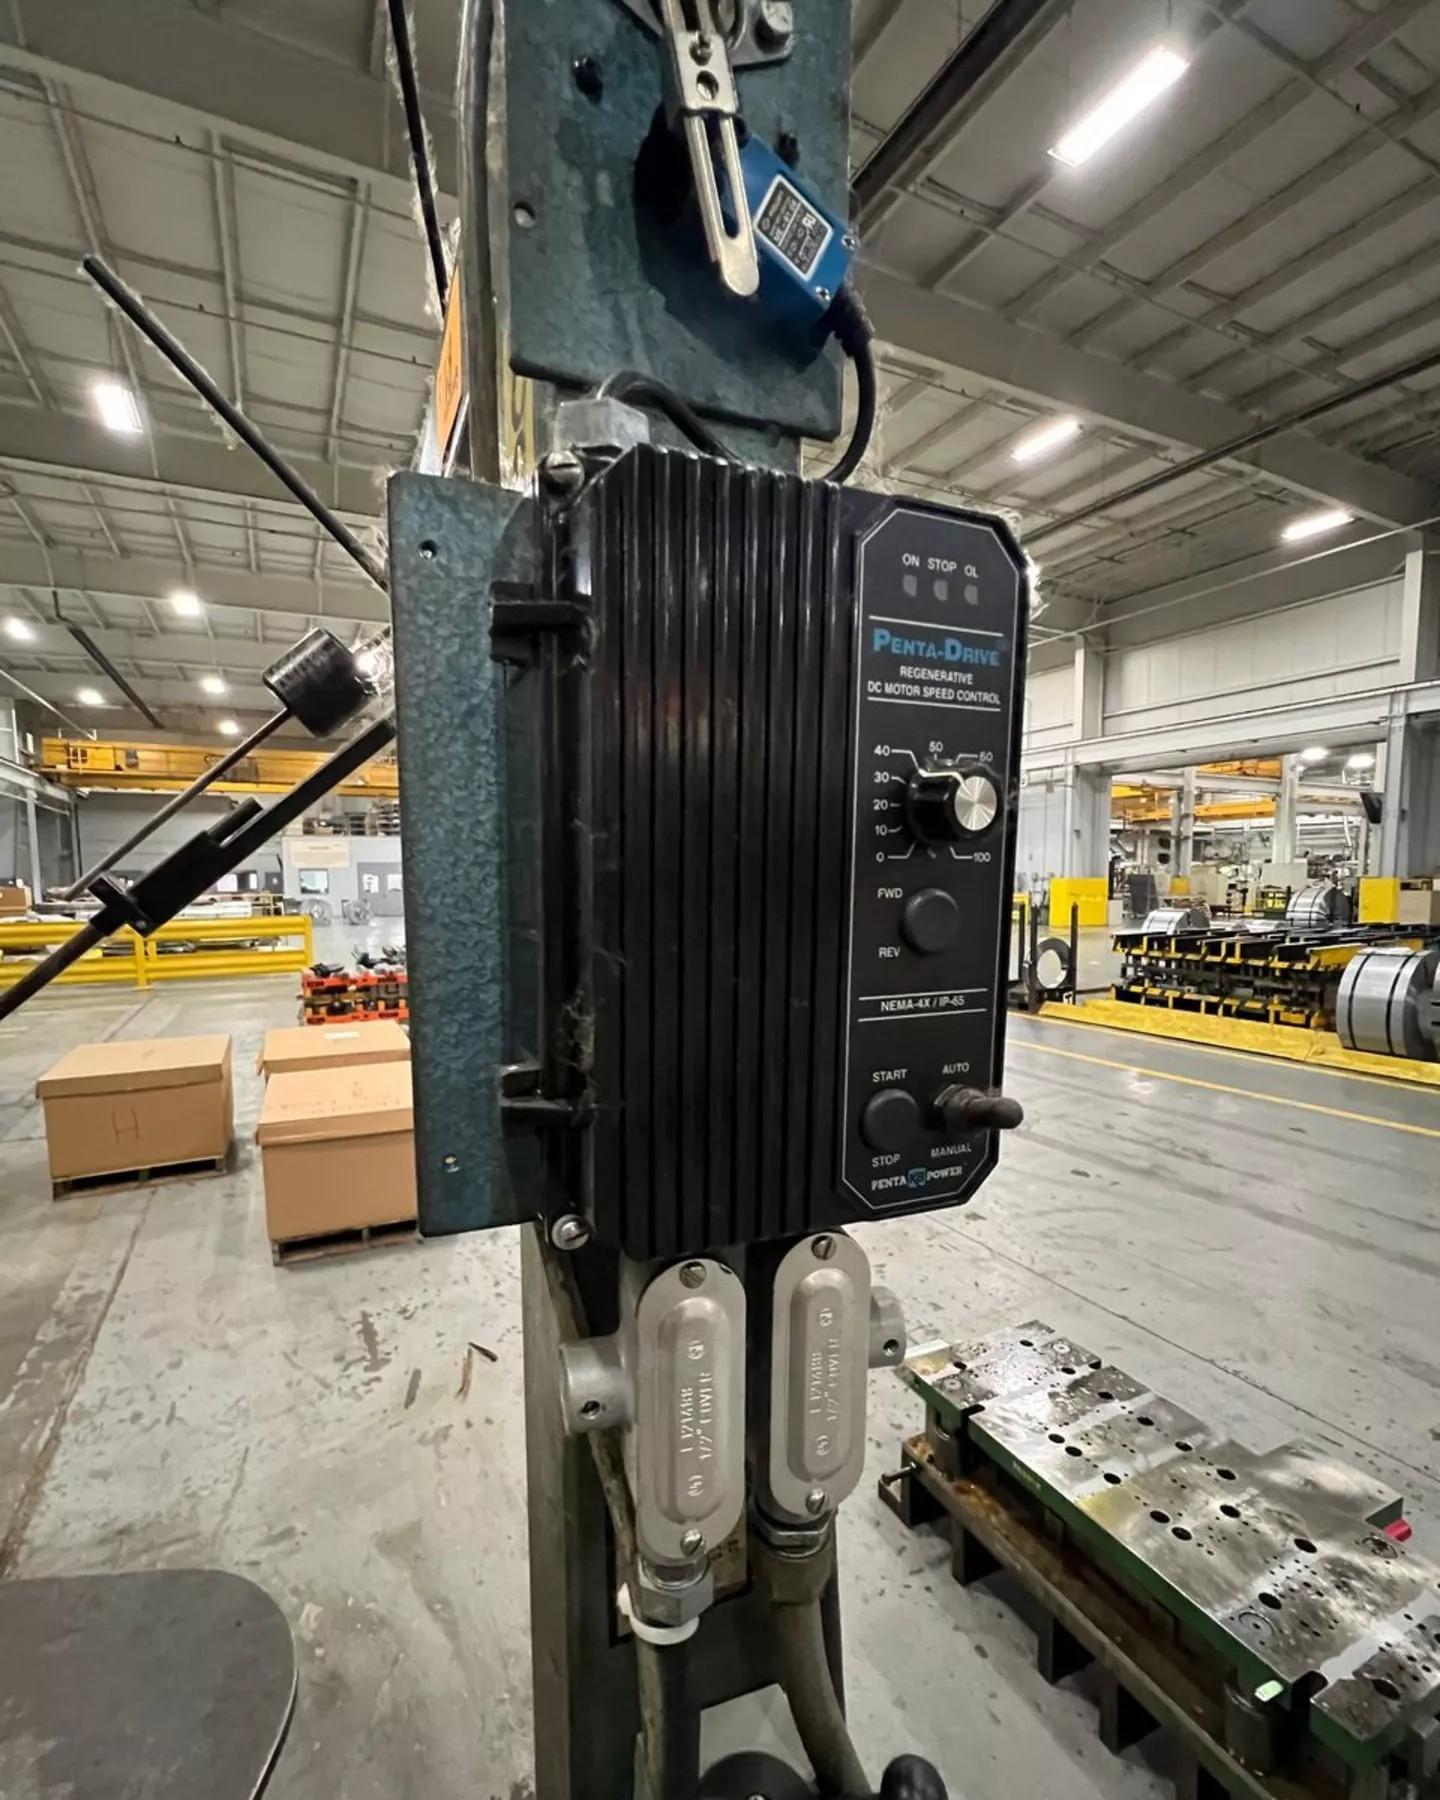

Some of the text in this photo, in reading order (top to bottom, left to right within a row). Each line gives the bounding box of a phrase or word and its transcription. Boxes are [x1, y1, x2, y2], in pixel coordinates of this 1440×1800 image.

[902, 553, 978, 578] ON STOP OL
[900, 666, 974, 686] REGENERATIVE
[867, 681, 1001, 705] DC MOTOR SPEED CONTROL
[874, 745, 890, 757] 40
[929, 741, 943, 753] 50
[873, 771, 889, 784] 30
[873, 800, 888, 811] 20
[875, 825, 888, 837] 10
[876, 852, 885, 863] 0
[974, 851, 991, 863] 100
[877, 887, 903, 899] FWD
[878, 946, 901, 959] REV
[880, 997, 931, 1012] NEMA-4X
[942, 1062, 970, 1075] AUTO
[872, 1069, 907, 1082] START
[930, 1143, 973, 1159] MANUAL
[872, 1154, 902, 1169] STOP
[871, 1175, 908, 1192] PENTA
[927, 1167, 963, 1183] POWER
